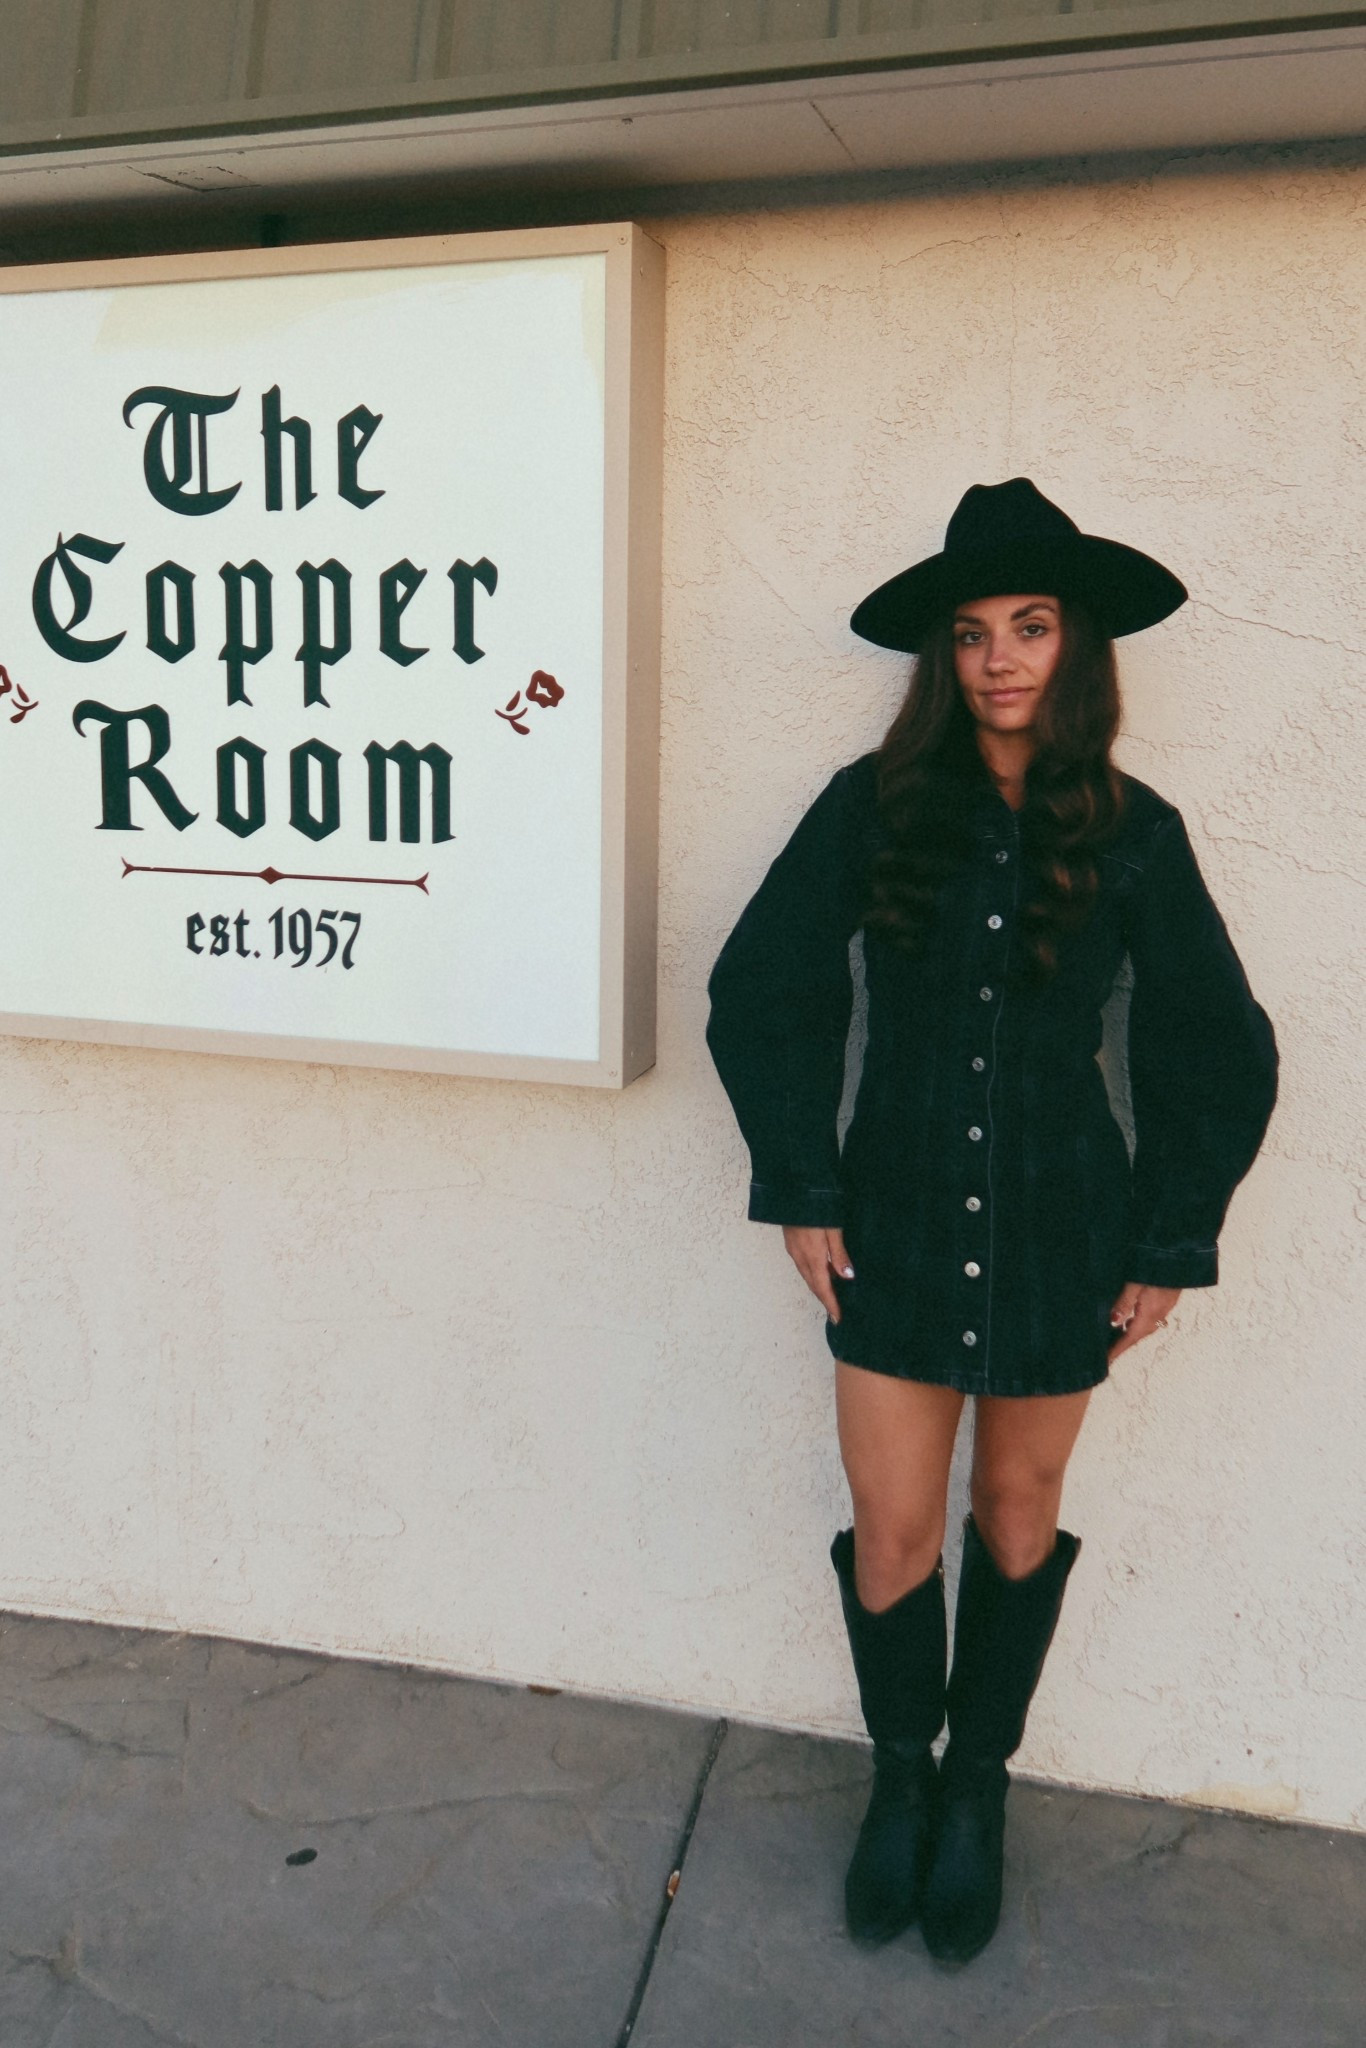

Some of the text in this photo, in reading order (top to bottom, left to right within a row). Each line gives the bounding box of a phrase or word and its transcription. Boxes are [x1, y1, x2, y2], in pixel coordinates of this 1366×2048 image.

[122, 384, 387, 517] The
[31, 532, 500, 709] Copper
[72, 699, 458, 846] Room
[186, 905, 362, 971] est. 1957
